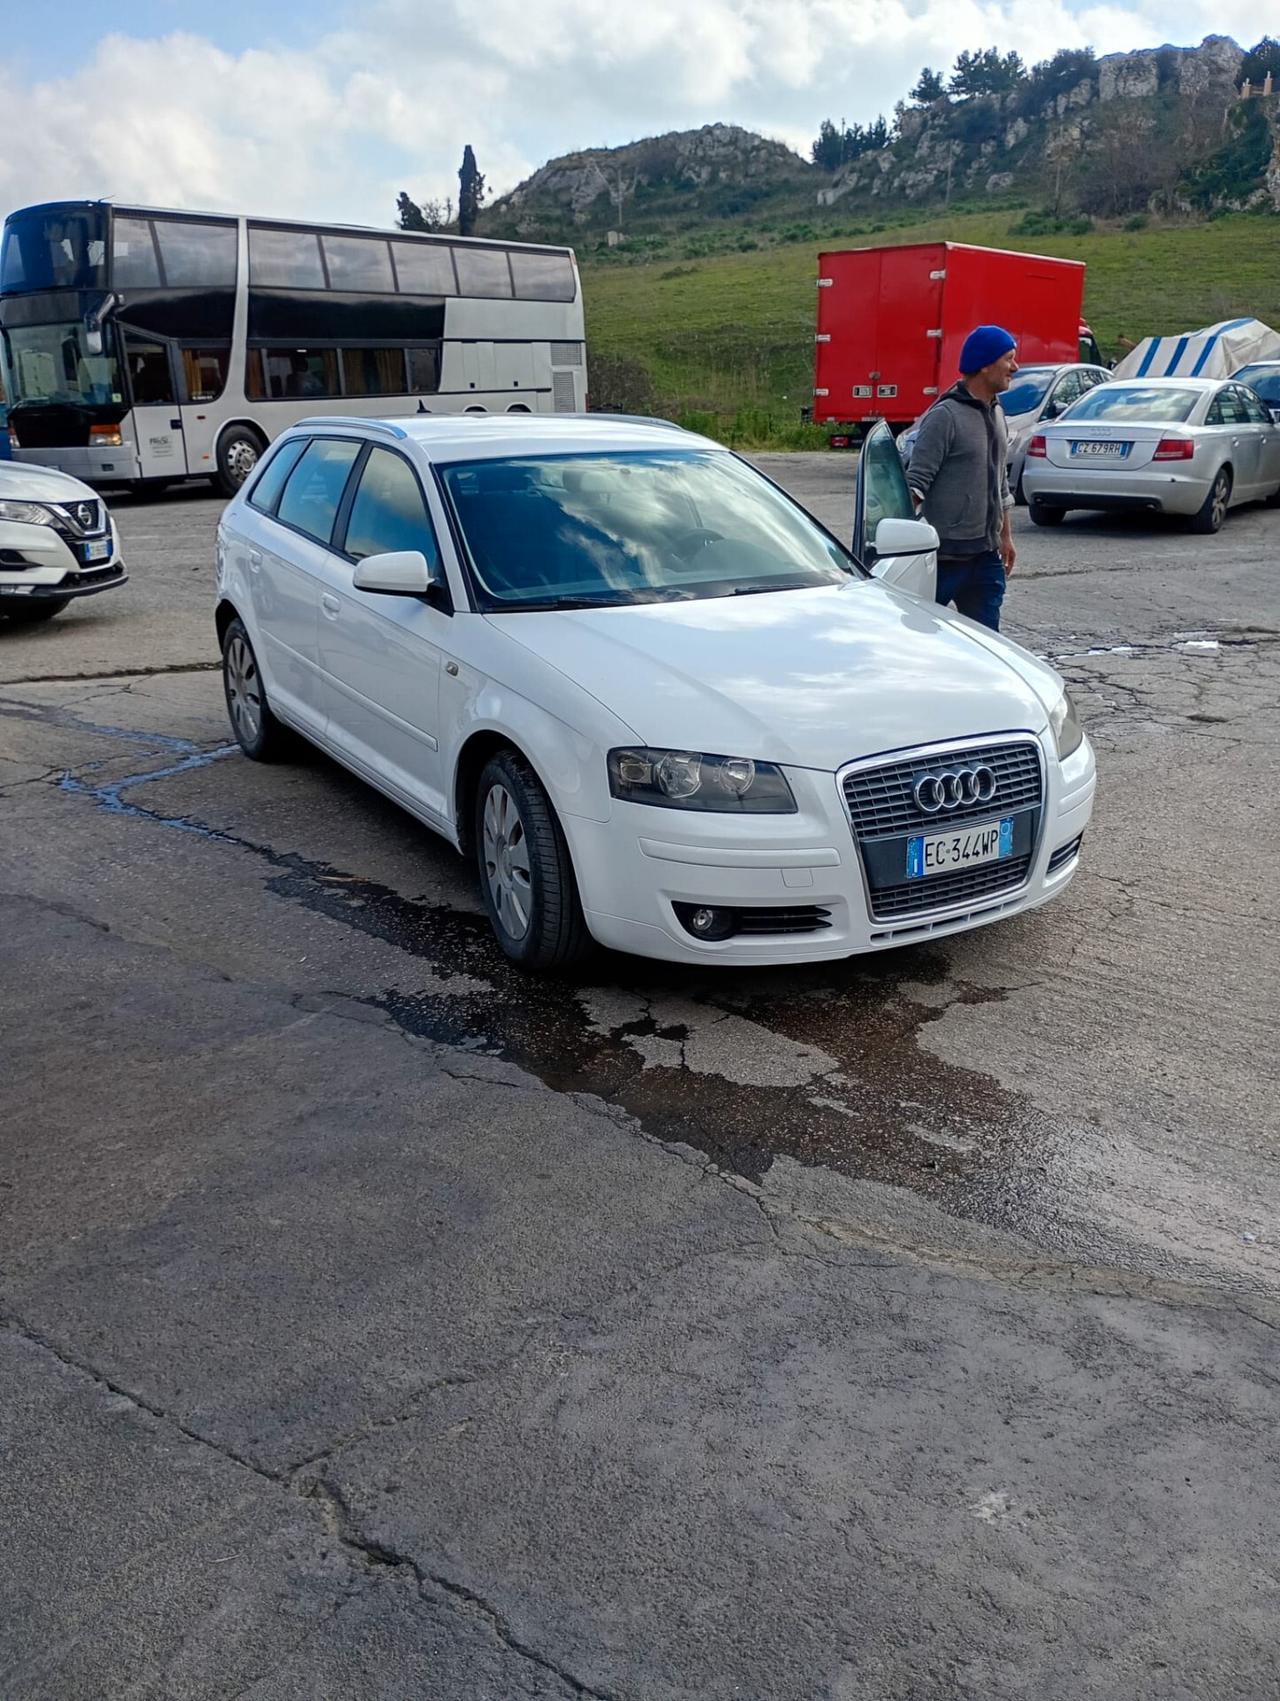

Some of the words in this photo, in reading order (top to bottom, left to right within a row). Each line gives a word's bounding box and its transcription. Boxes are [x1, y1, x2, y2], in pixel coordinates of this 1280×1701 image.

[1078, 443, 1088, 453] CZ
[1091, 443, 1120, 455] 679RH
[926, 841, 946, 867] EC
[952, 830, 999, 862] 344WP
